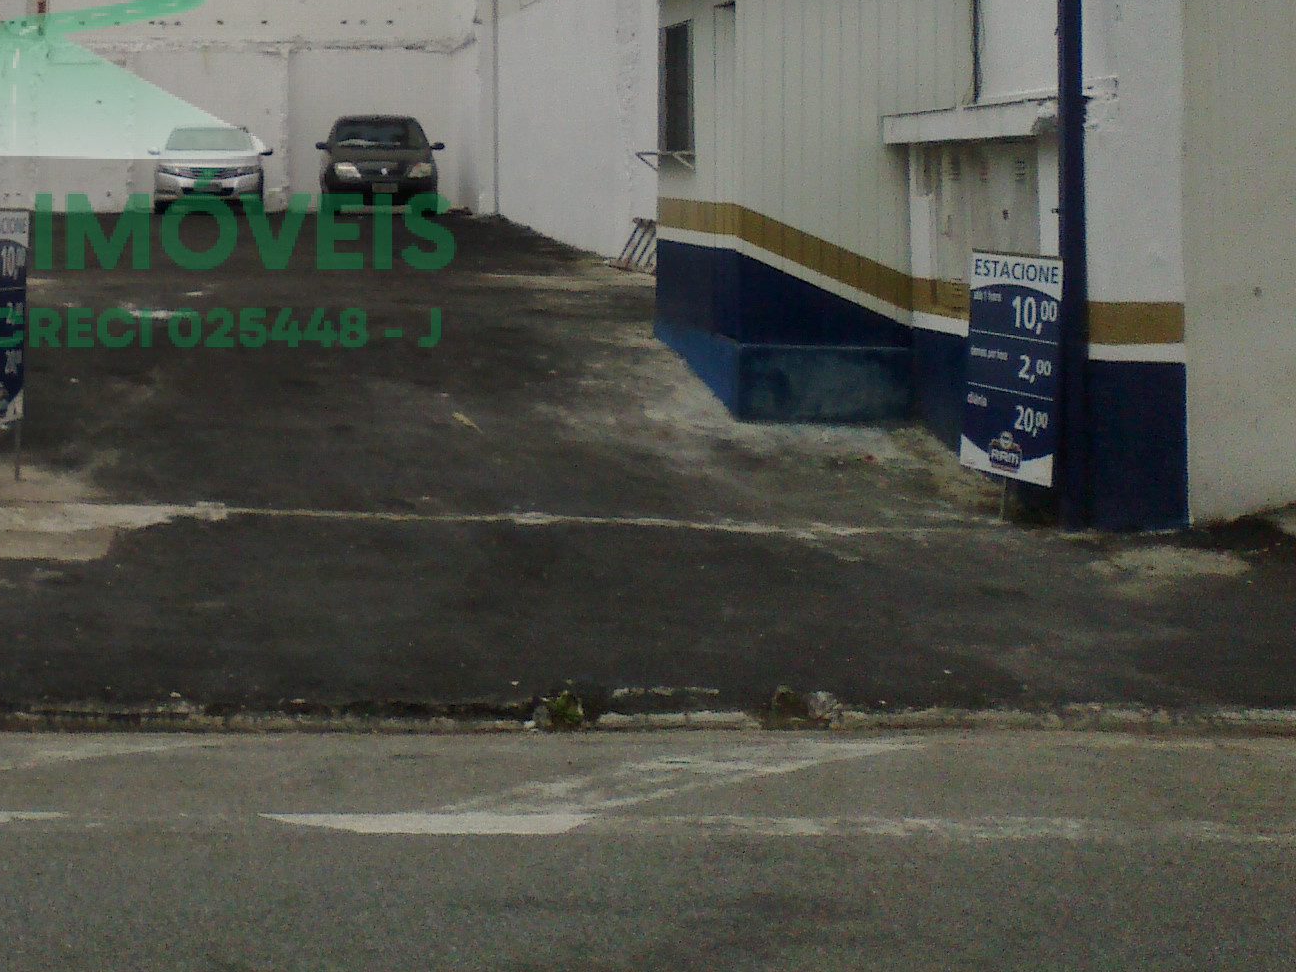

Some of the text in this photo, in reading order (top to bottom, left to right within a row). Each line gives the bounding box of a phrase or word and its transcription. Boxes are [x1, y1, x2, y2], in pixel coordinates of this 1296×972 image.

[975, 258, 1059, 284] ESTACIONE
[1012, 295, 1058, 335] 10,00
[1018, 354, 1052, 384] 2,00
[1014, 405, 1048, 438] 20,00
